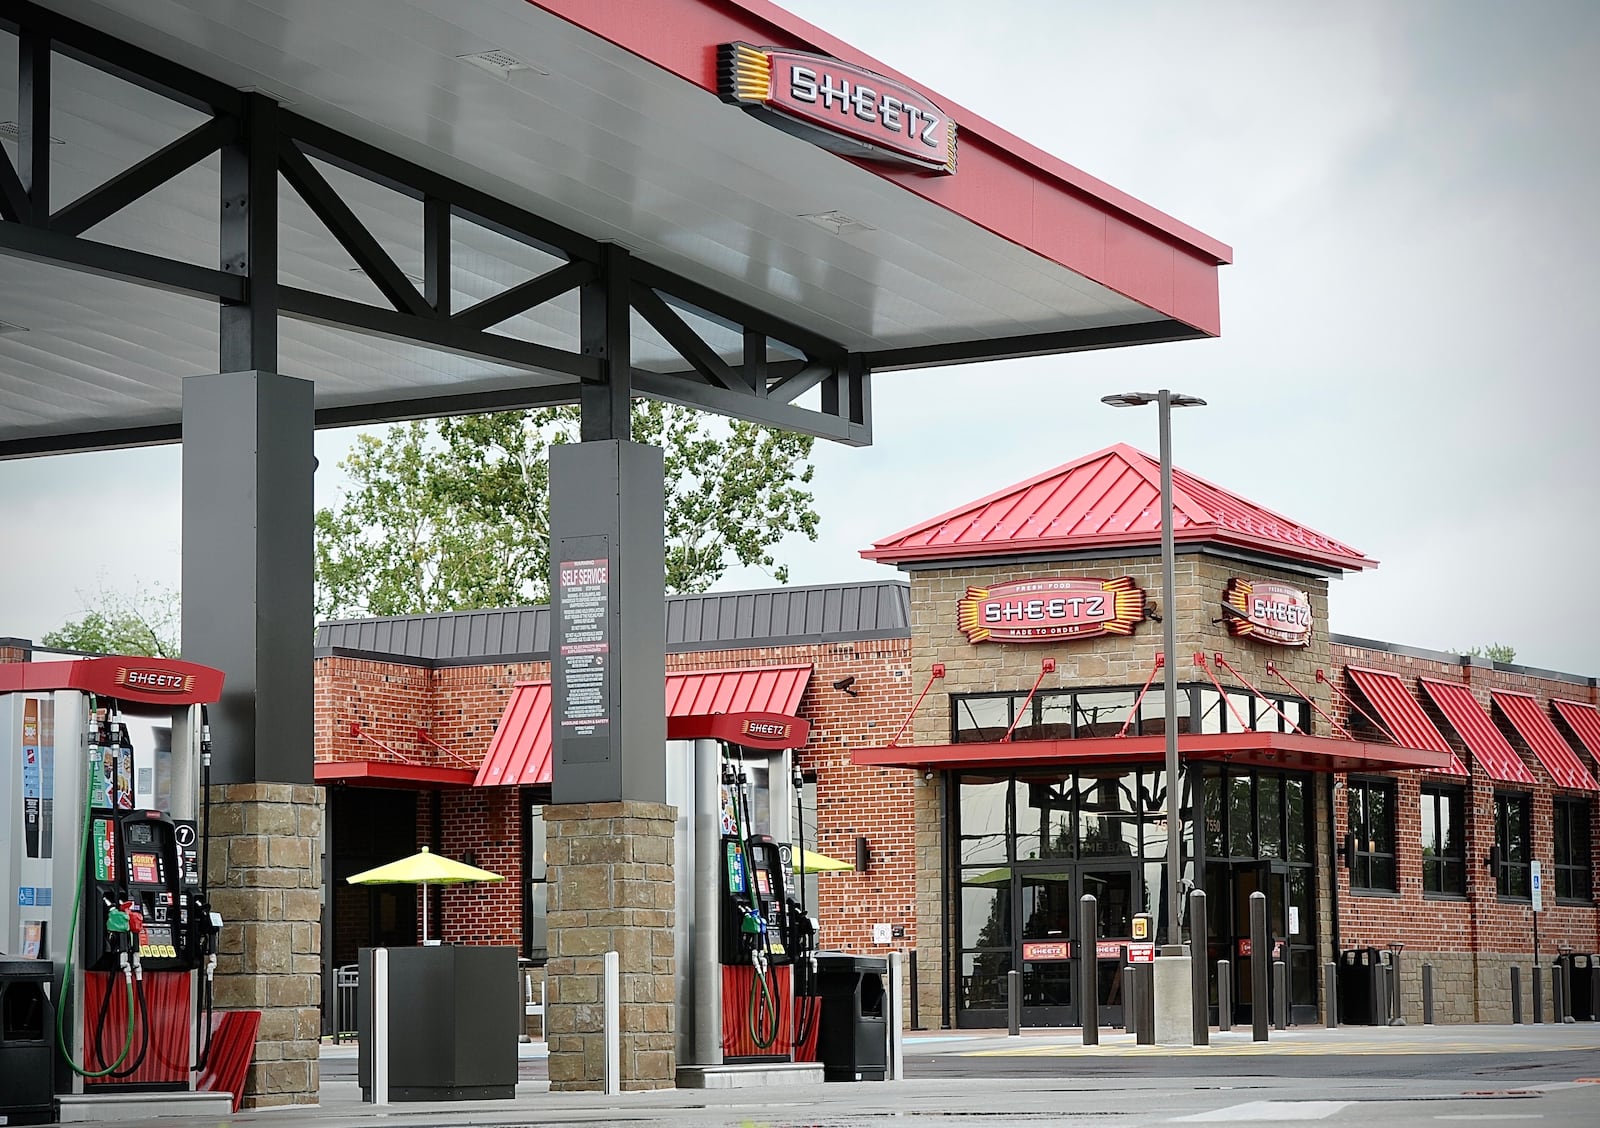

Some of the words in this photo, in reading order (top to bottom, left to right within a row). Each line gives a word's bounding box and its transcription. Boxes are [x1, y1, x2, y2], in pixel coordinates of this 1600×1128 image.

[790, 65, 941, 148] SHEETZ
[562, 570, 578, 586] SELF
[579, 567, 606, 585] SERVICE
[1016, 584, 1043, 592] FRESH
[985, 596, 1106, 622] SHEETZ
[1254, 598, 1309, 626] SHEETZ
[1051, 626, 1080, 634] ORDER
[128, 671, 183, 687] SHEETZ
[750, 723, 784, 735] SHEETZ
[1153, 819, 1183, 832] 750
[181, 828, 188, 842] 7
[132, 855, 154, 864] SORRY
